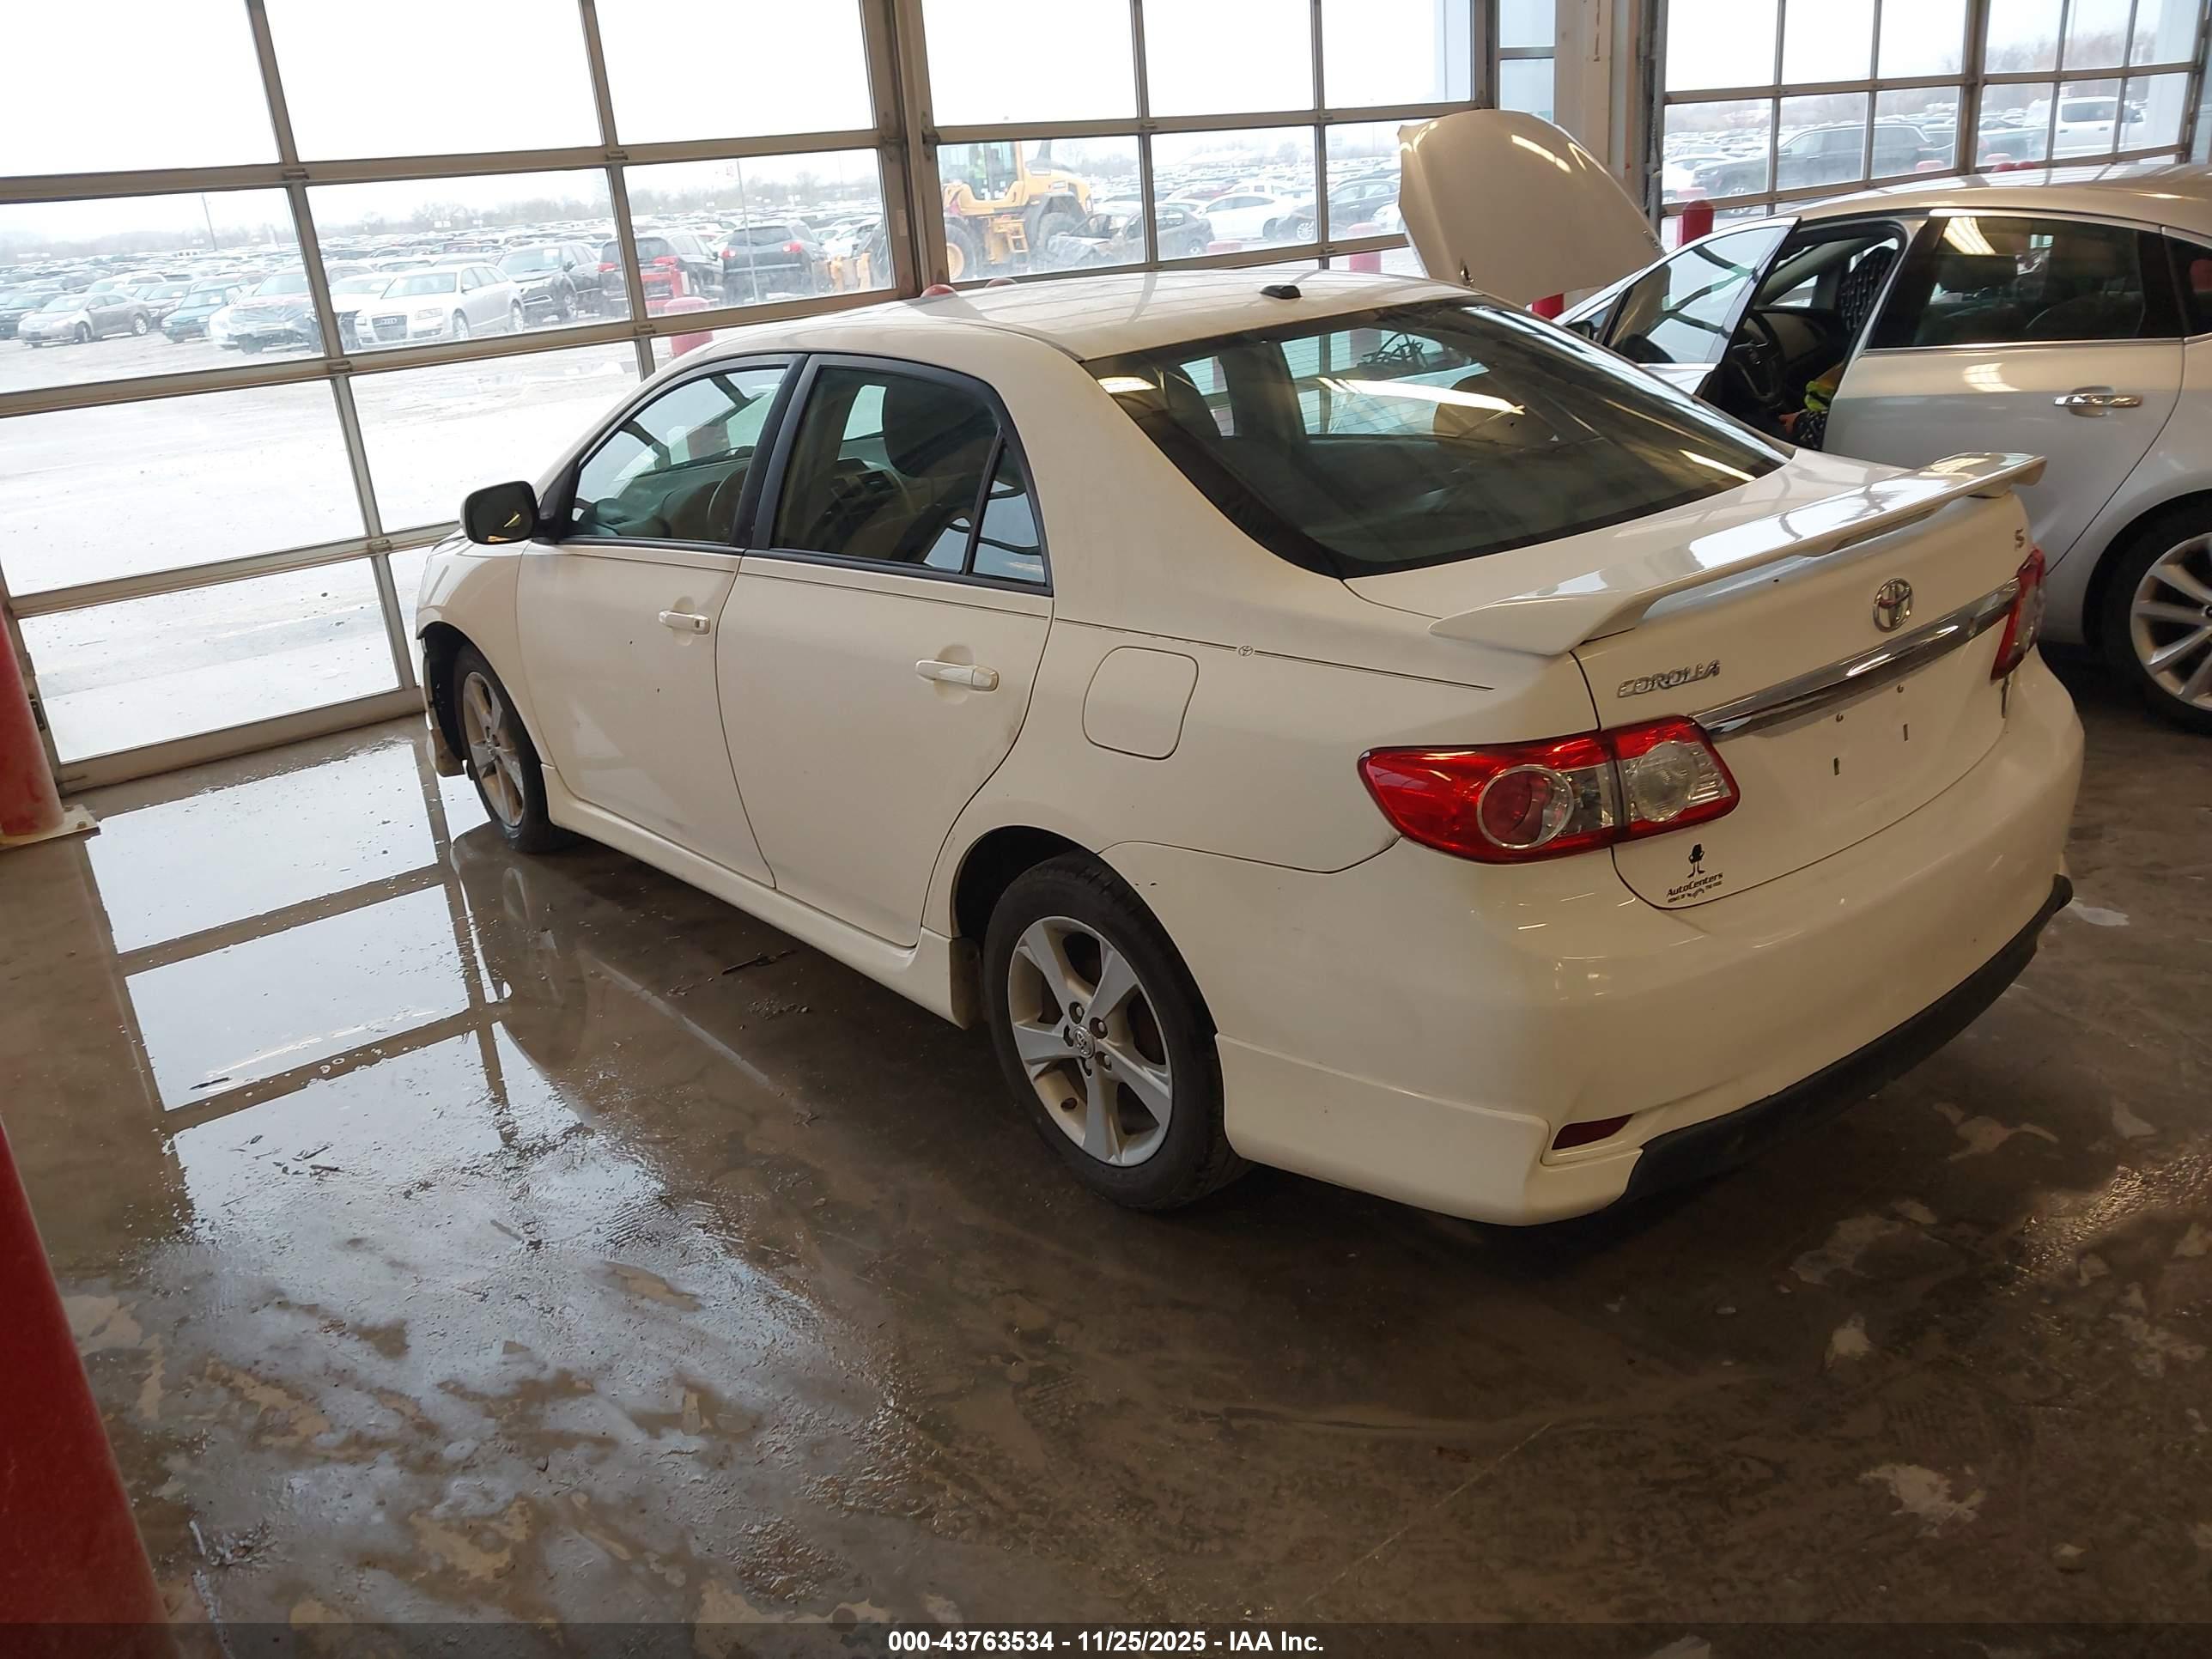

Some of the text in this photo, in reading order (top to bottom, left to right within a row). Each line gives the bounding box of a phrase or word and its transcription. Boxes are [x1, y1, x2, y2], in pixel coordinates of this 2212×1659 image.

[2014, 528, 2026, 551] S
[1617, 659, 1720, 698] COROLLA
[1666, 872, 1723, 896] AutoCenters
